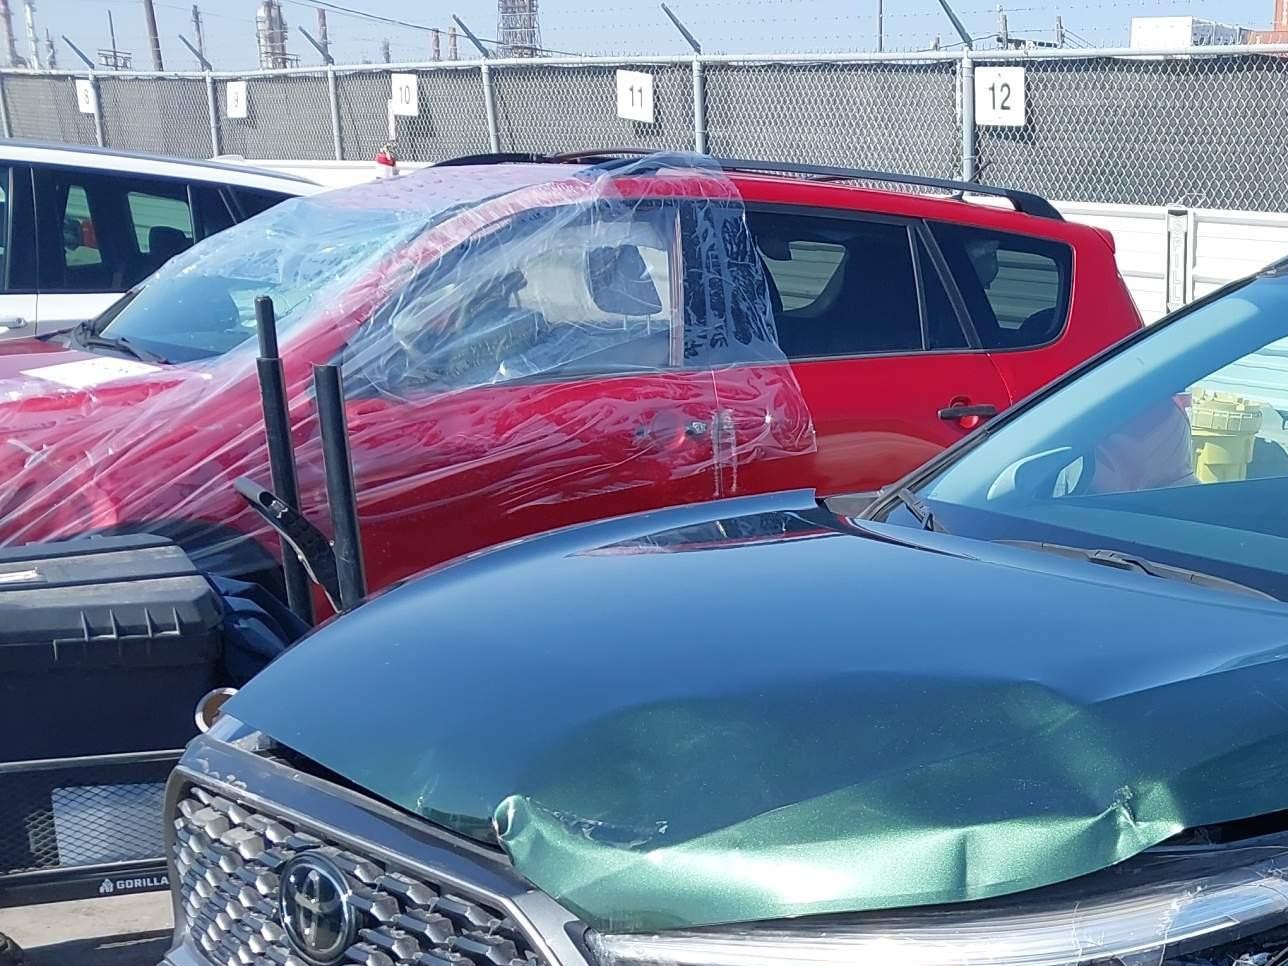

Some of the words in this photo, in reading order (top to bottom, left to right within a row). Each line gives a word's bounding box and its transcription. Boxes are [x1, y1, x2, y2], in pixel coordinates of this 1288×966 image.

[399, 84, 411, 105] 10
[628, 83, 643, 109] 11
[988, 82, 1011, 110] 12
[116, 875, 169, 889] GORILLA
